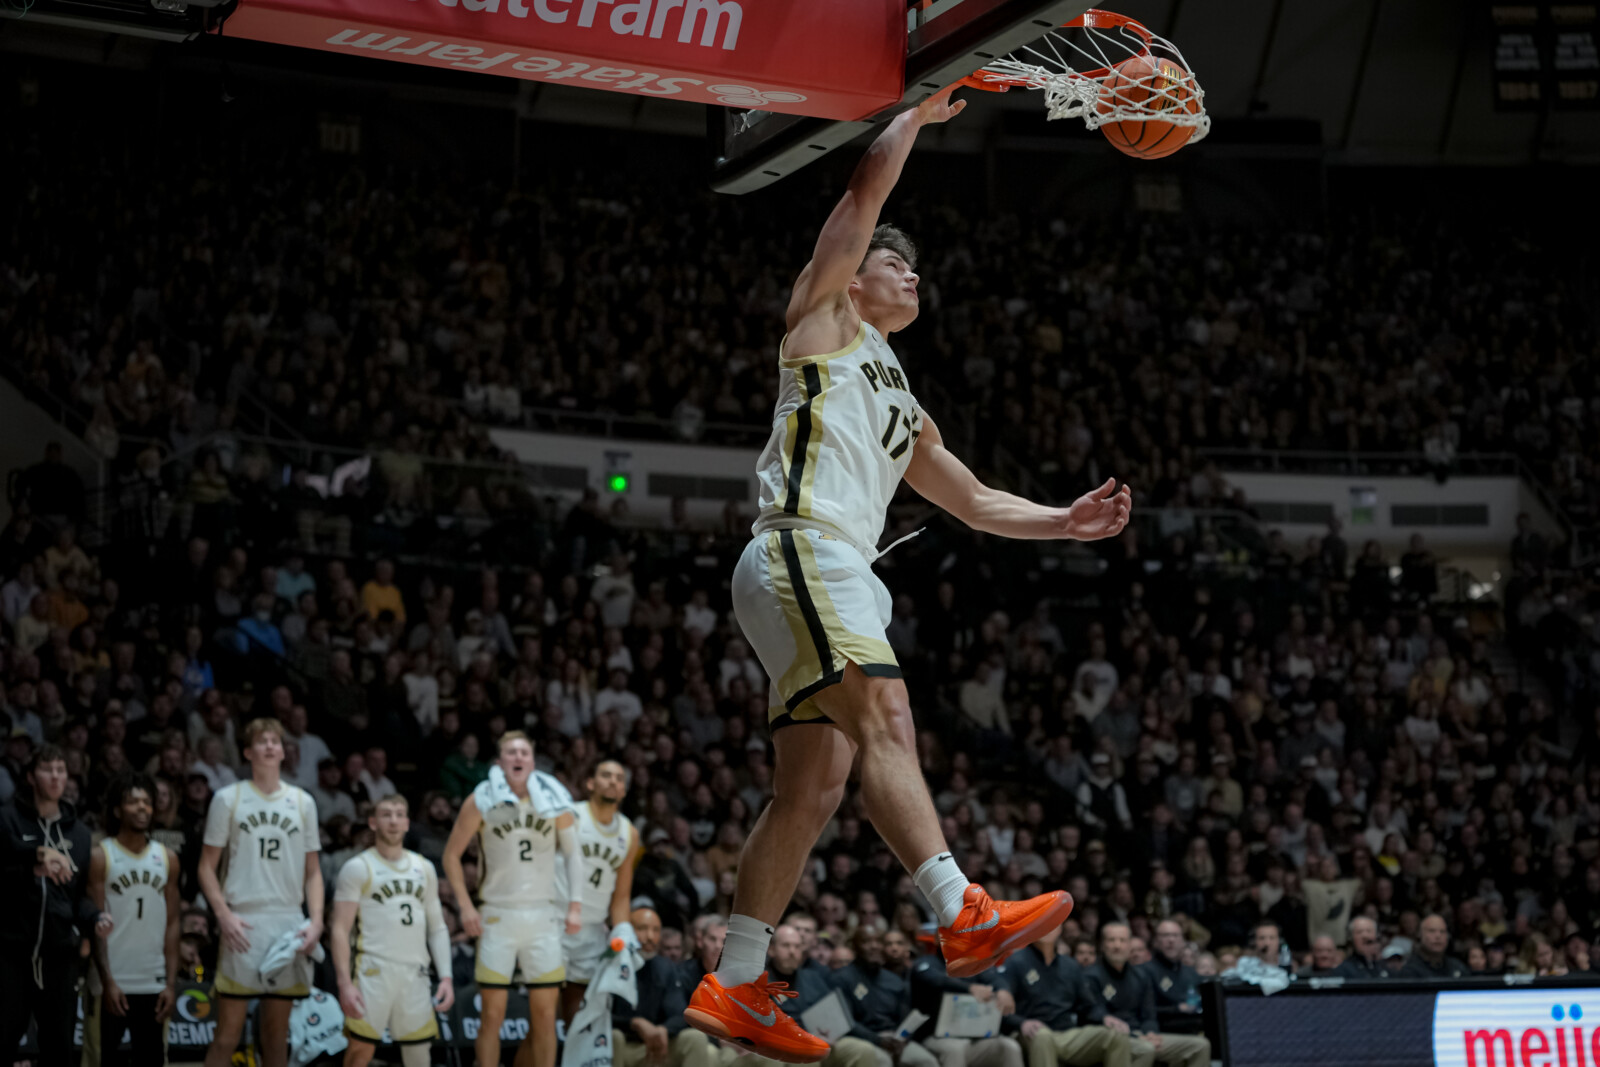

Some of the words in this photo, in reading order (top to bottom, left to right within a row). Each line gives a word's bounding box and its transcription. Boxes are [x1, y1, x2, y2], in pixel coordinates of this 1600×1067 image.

[238, 811, 300, 837] PURDUE
[258, 837, 280, 861] 12
[519, 840, 533, 861] 2
[589, 866, 602, 889] 4
[371, 880, 424, 904] PURDU
[136, 898, 144, 919] 1
[400, 903, 413, 926] 3
